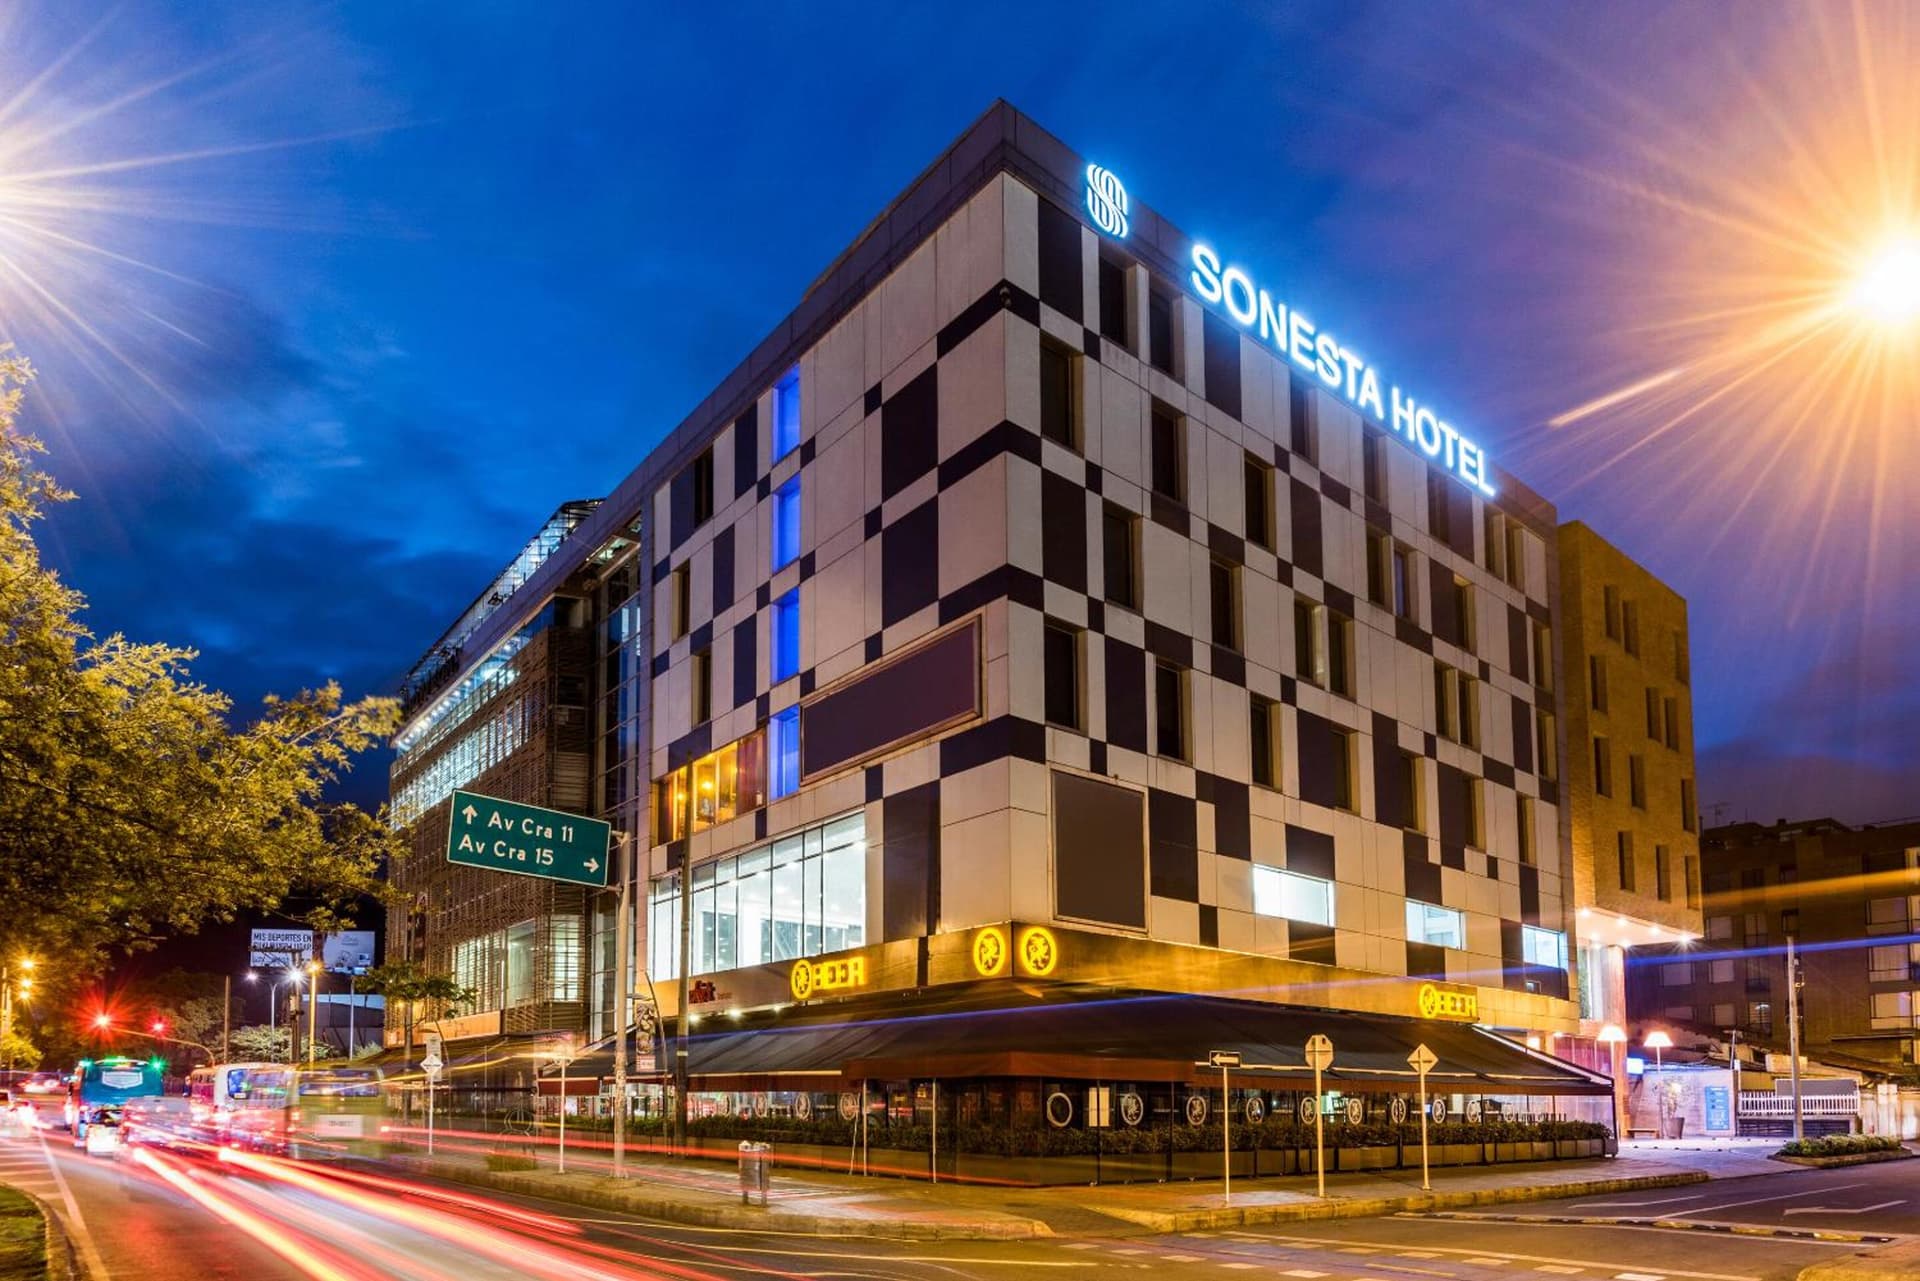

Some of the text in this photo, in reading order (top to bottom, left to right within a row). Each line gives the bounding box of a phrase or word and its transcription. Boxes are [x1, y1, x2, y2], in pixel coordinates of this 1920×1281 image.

[1191, 244, 1496, 497] SONESTA HOTEL
[488, 811, 573, 843] Av Cra 11
[458, 834, 554, 865] Av Cra 15
